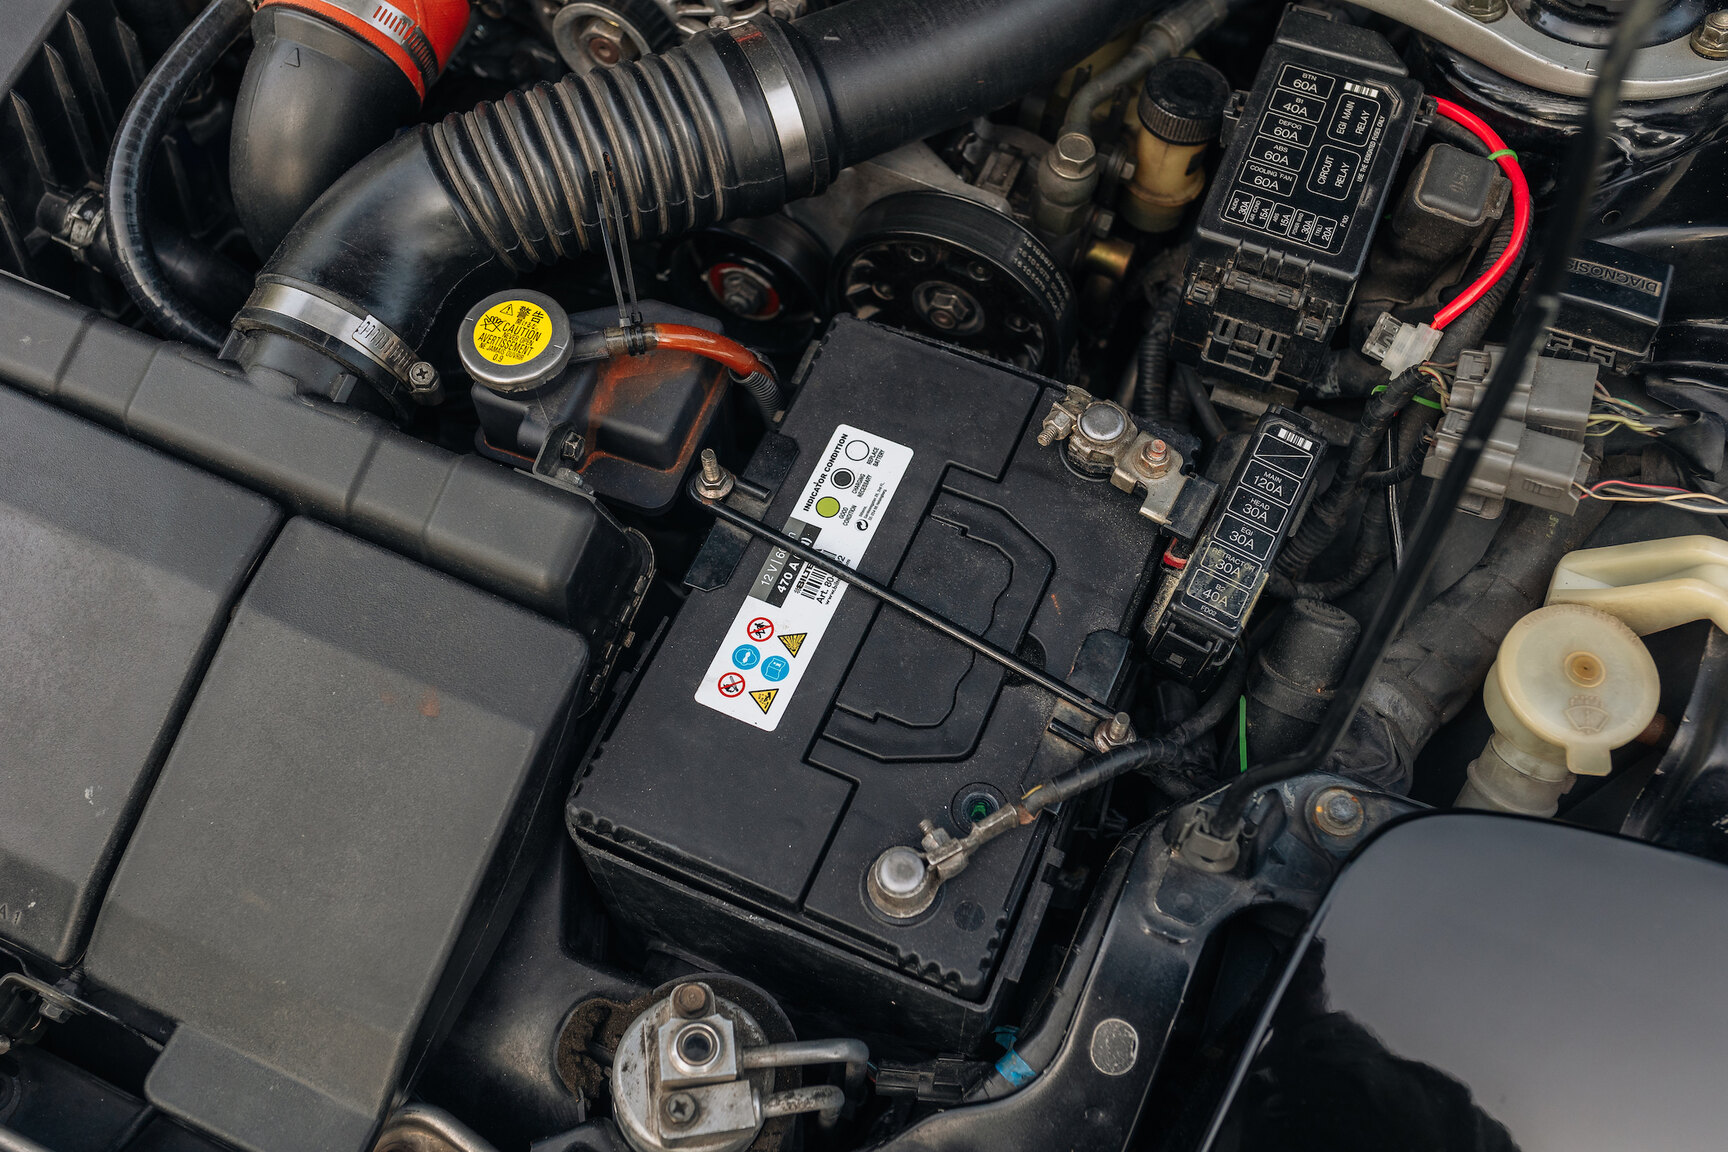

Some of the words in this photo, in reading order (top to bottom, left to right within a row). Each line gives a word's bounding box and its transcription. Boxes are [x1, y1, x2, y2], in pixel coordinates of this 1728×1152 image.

[1302, 73, 1317, 81] BTN
[1293, 79, 1318, 93] 60A
[1283, 103, 1308, 116] 40A
[1279, 119, 1302, 130] DEFOG
[1336, 121, 1347, 134] EGI
[1342, 101, 1355, 120] MAIN
[1355, 110, 1370, 134] RELAY
[1274, 127, 1298, 141] 60A
[1274, 144, 1288, 153] ABS
[1264, 151, 1289, 166] 60A
[1250, 165, 1277, 177] COOLING
[1280, 173, 1293, 181] FAN
[1318, 155, 1334, 184] CIRCUIT
[1335, 162, 1350, 188] RELAY
[1254, 176, 1279, 190] 60A
[1239, 201, 1250, 215] 30A
[1260, 208, 1270, 220] 15A
[1280, 214, 1291, 227] 15A
[1301, 220, 1312, 234] 30A
[1322, 226, 1333, 241] 20A
[502, 332, 520, 341] NEVER
[503, 322, 541, 341] CAUTION
[478, 333, 534, 356] AVERTISSEMENT
[492, 354, 504, 362] 0.9
[867, 447, 880, 465] REPLACE
[873, 449, 885, 467] BATTERY
[803, 473, 827, 512] INDICATOR
[824, 433, 848, 472] CONDITION
[1264, 471, 1282, 484] MAIN
[852, 473, 866, 494] CHARGING
[857, 474, 872, 497] NECESSARY
[1253, 475, 1283, 497] 120A
[1250, 498, 1270, 511] HEAD
[839, 507, 848, 519] GOOD
[843, 505, 857, 526] CONDITION
[1242, 504, 1268, 523] 30A
[1240, 526, 1253, 536] EGI
[1229, 530, 1254, 550] 30A
[1212, 547, 1256, 572] RETRACTOR
[762, 574, 774, 586] 12
[768, 564, 778, 572] V
[1216, 559, 1241, 579] 30A
[778, 572, 793, 593] 470
[789, 561, 800, 571] A
[1215, 584, 1225, 592] B2
[817, 590, 829, 604] Art.
[1202, 588, 1228, 608] 40A
[1200, 605, 1217, 618] FD02
